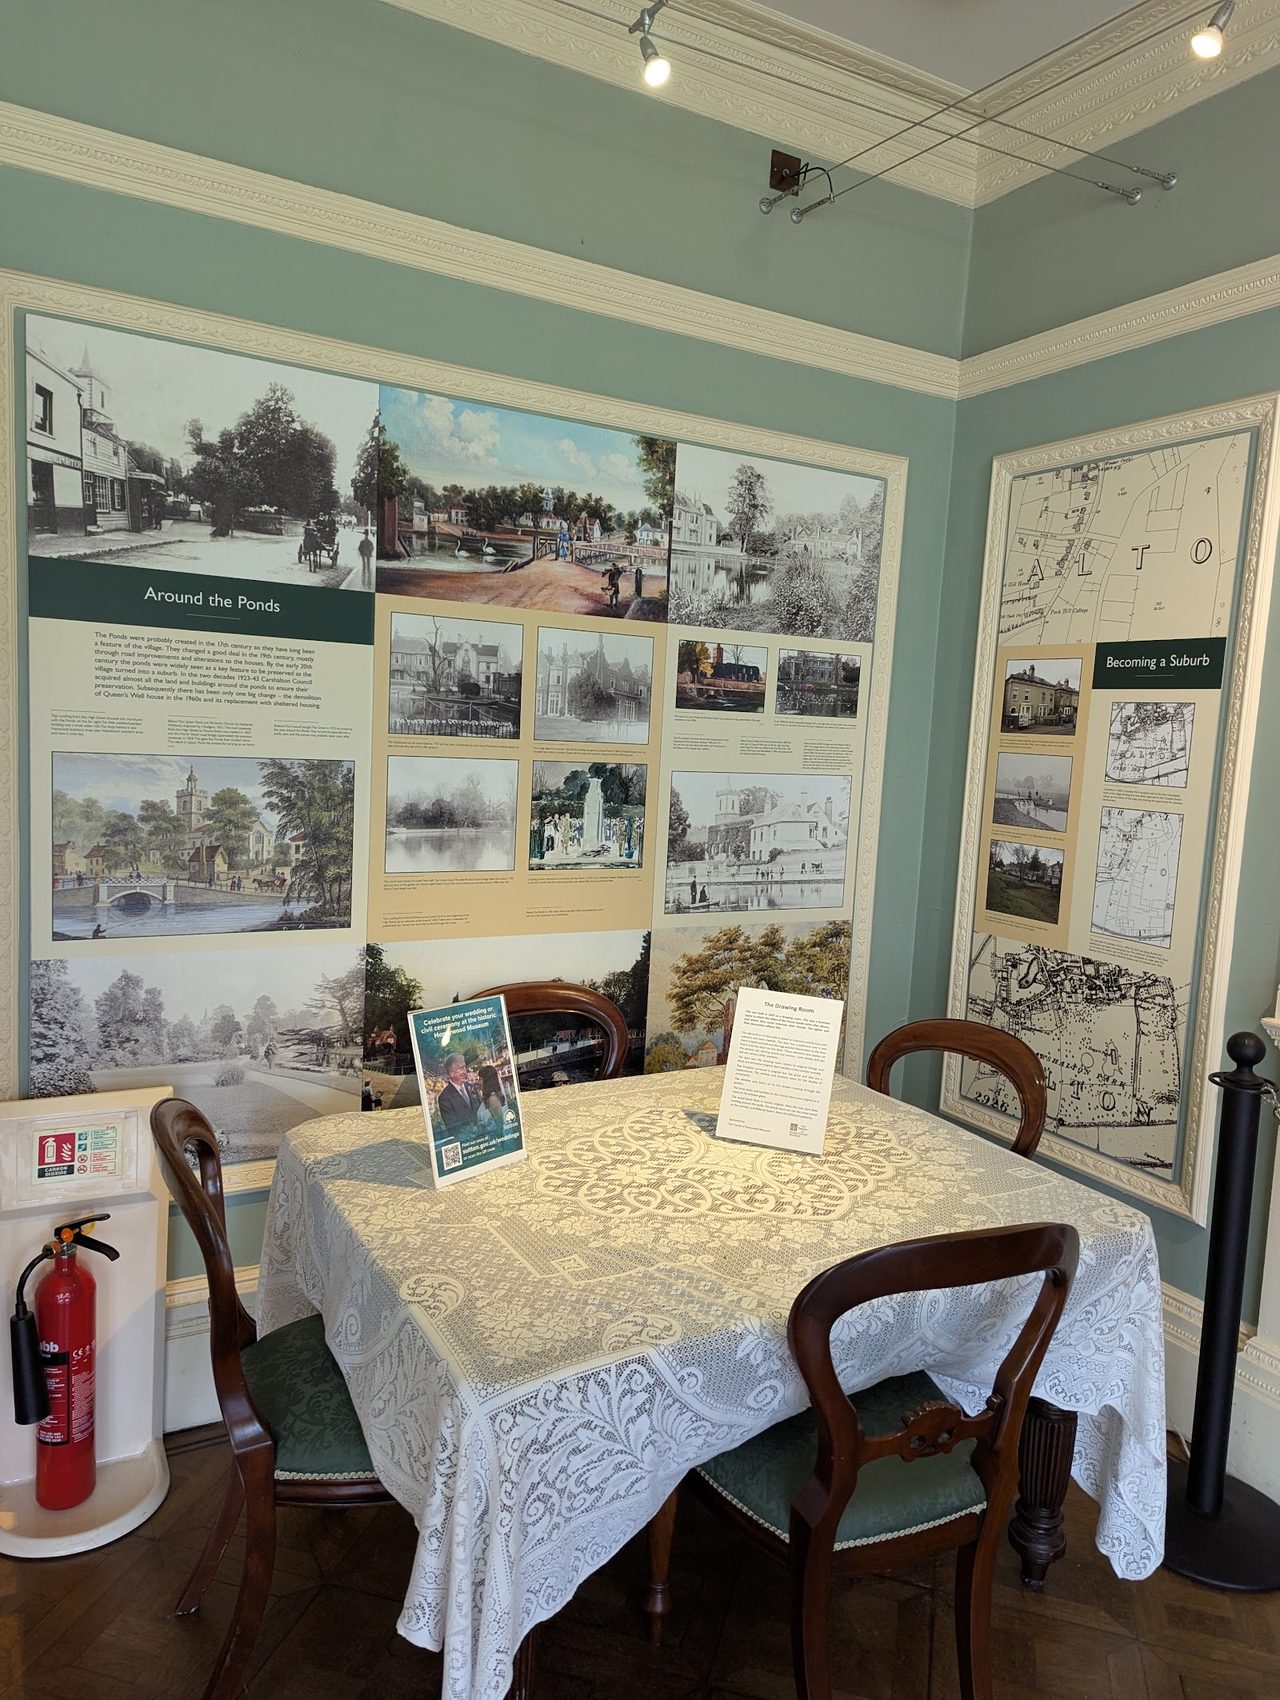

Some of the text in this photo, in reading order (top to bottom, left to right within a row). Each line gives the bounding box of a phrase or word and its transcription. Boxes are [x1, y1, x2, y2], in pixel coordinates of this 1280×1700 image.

[144, 586, 280, 613] Around the Ponds
[100, 640, 122, 649] feature
[167, 645, 180, 655] They
[182, 647, 205, 656] changed
[212, 650, 227, 658] good
[296, 656, 314, 665] mostly
[109, 632, 128, 641] Ponds
[147, 636, 173, 646] probably
[231, 643, 252, 652] century
[262, 644, 274, 654] they
[289, 647, 301, 656] long
[95, 648, 119, 658] through
[137, 651, 179, 661] improvements
[194, 656, 223, 664] alterations
[267, 661, 273, 670] By
[286, 663, 299, 672] early
[95, 657, 118, 667] century
[132, 660, 151, 668] ponds
[170, 662, 188, 672] widely
[218, 665, 228, 674] key
[229, 666, 249, 674] feature
[1106, 654, 1210, 670] Becoming a Suburb
[95, 665, 113, 675] village
[115, 666, 136, 674] turned
[213, 673, 235, 681] decades
[261, 676, 291, 684] Carshalton
[292, 678, 312, 686] Council
[95, 675, 121, 683] acquired
[191, 680, 216, 690] buildings
[250, 684, 267, 692] ponds
[137, 684, 175, 695] Subsequently
[222, 690, 234, 698] only
[248, 691, 256, 700] big
[257, 691, 276, 701] change
[293, 693, 322, 702] demolition
[224, 698, 258, 706] replacement
[273, 700, 298, 708] sheltered
[299, 701, 320, 711] housing
[424, 1015, 451, 1026] Celebrate
[465, 1008, 487, 1016] wedding
[478, 1012, 497, 1021] historic
[467, 1021, 489, 1031] Museum
[463, 1132, 519, 1154] sutton.gov.uk/weddings
